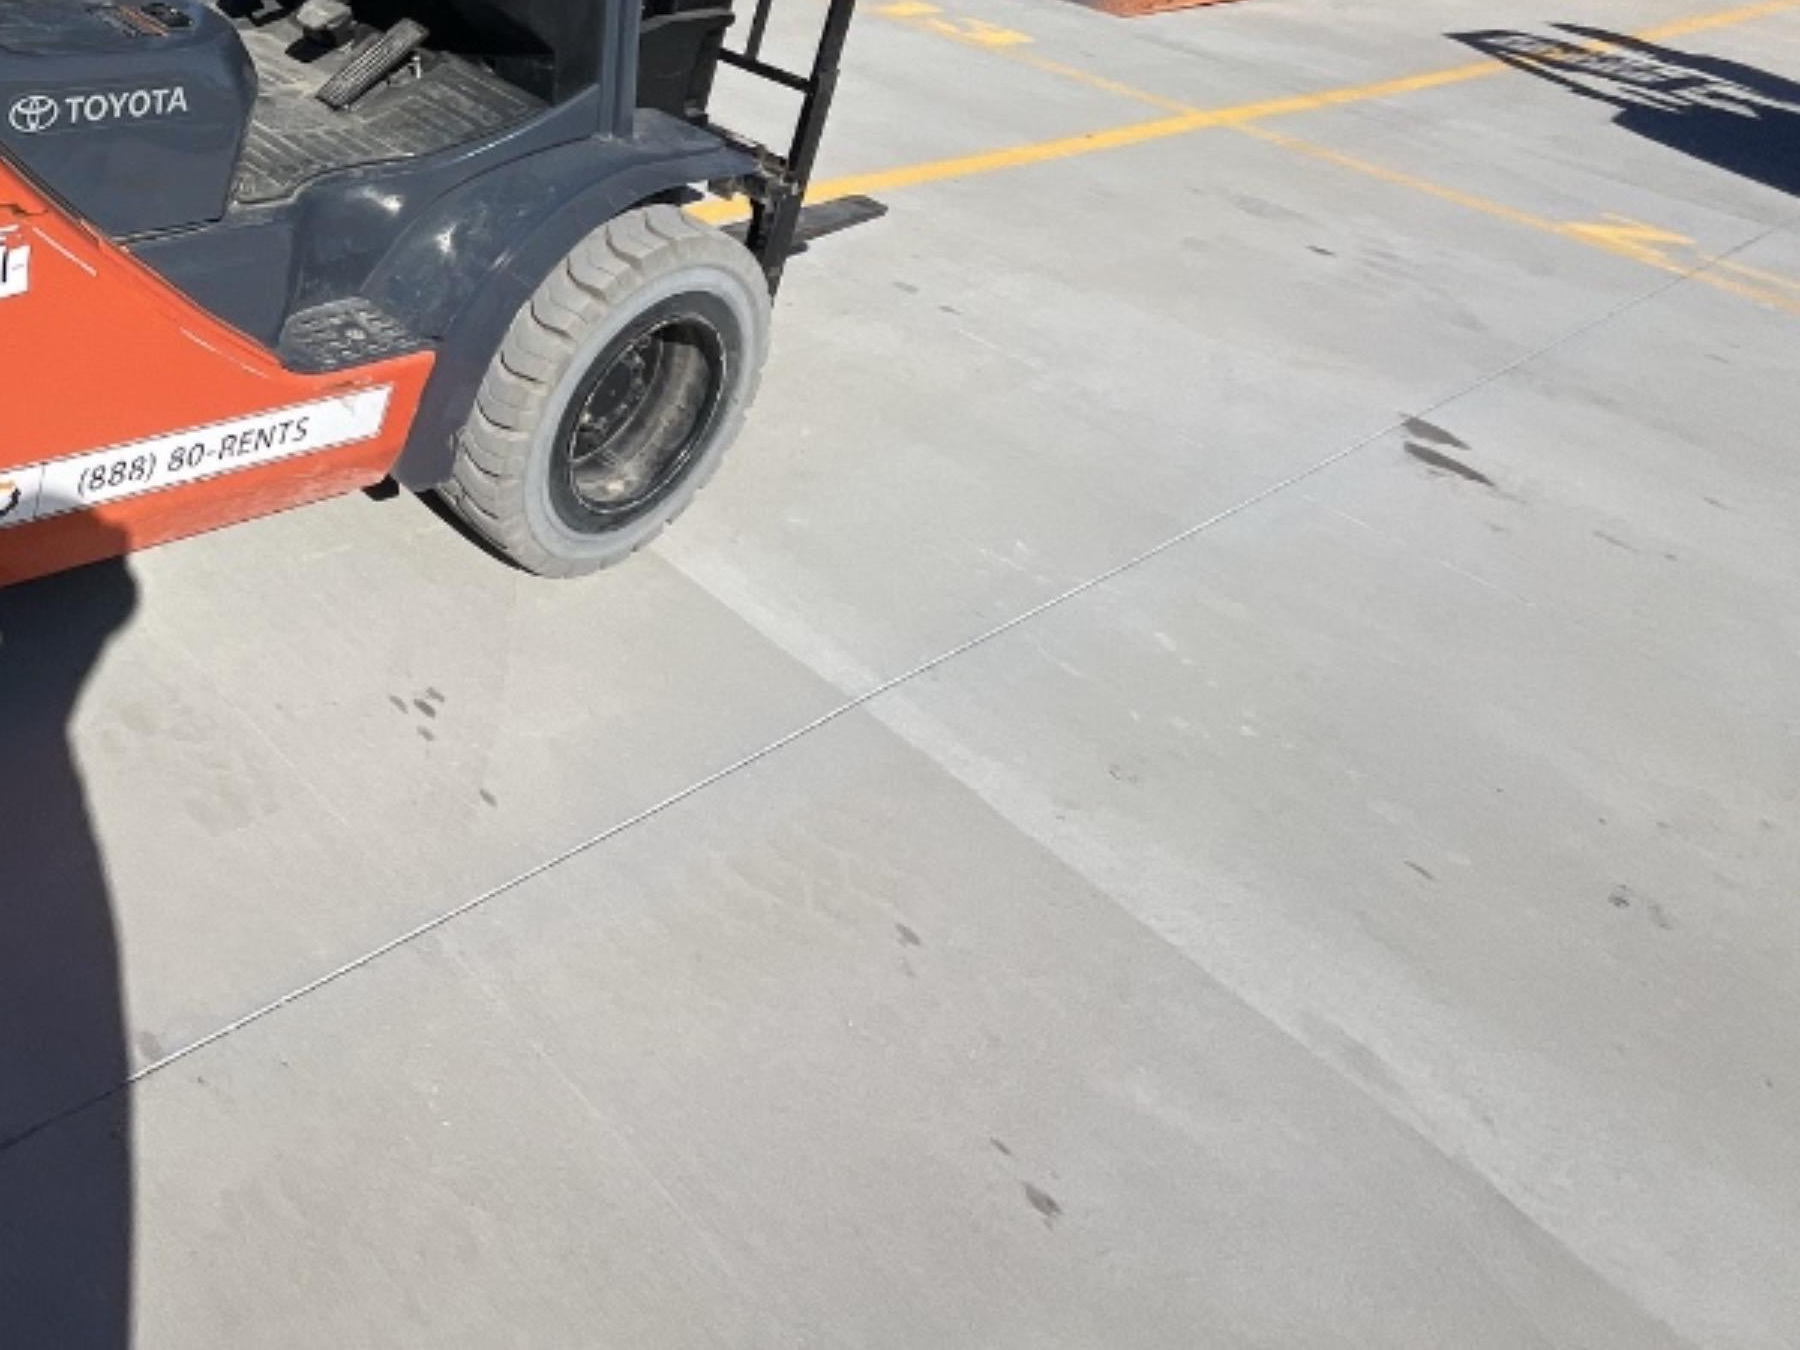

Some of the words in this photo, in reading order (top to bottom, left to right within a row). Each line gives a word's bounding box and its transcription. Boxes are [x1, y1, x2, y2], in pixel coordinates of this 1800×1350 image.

[64, 85, 189, 124] TOYOTA
[77, 452, 158, 497] (888)
[167, 416, 311, 472] 80-RENTS
